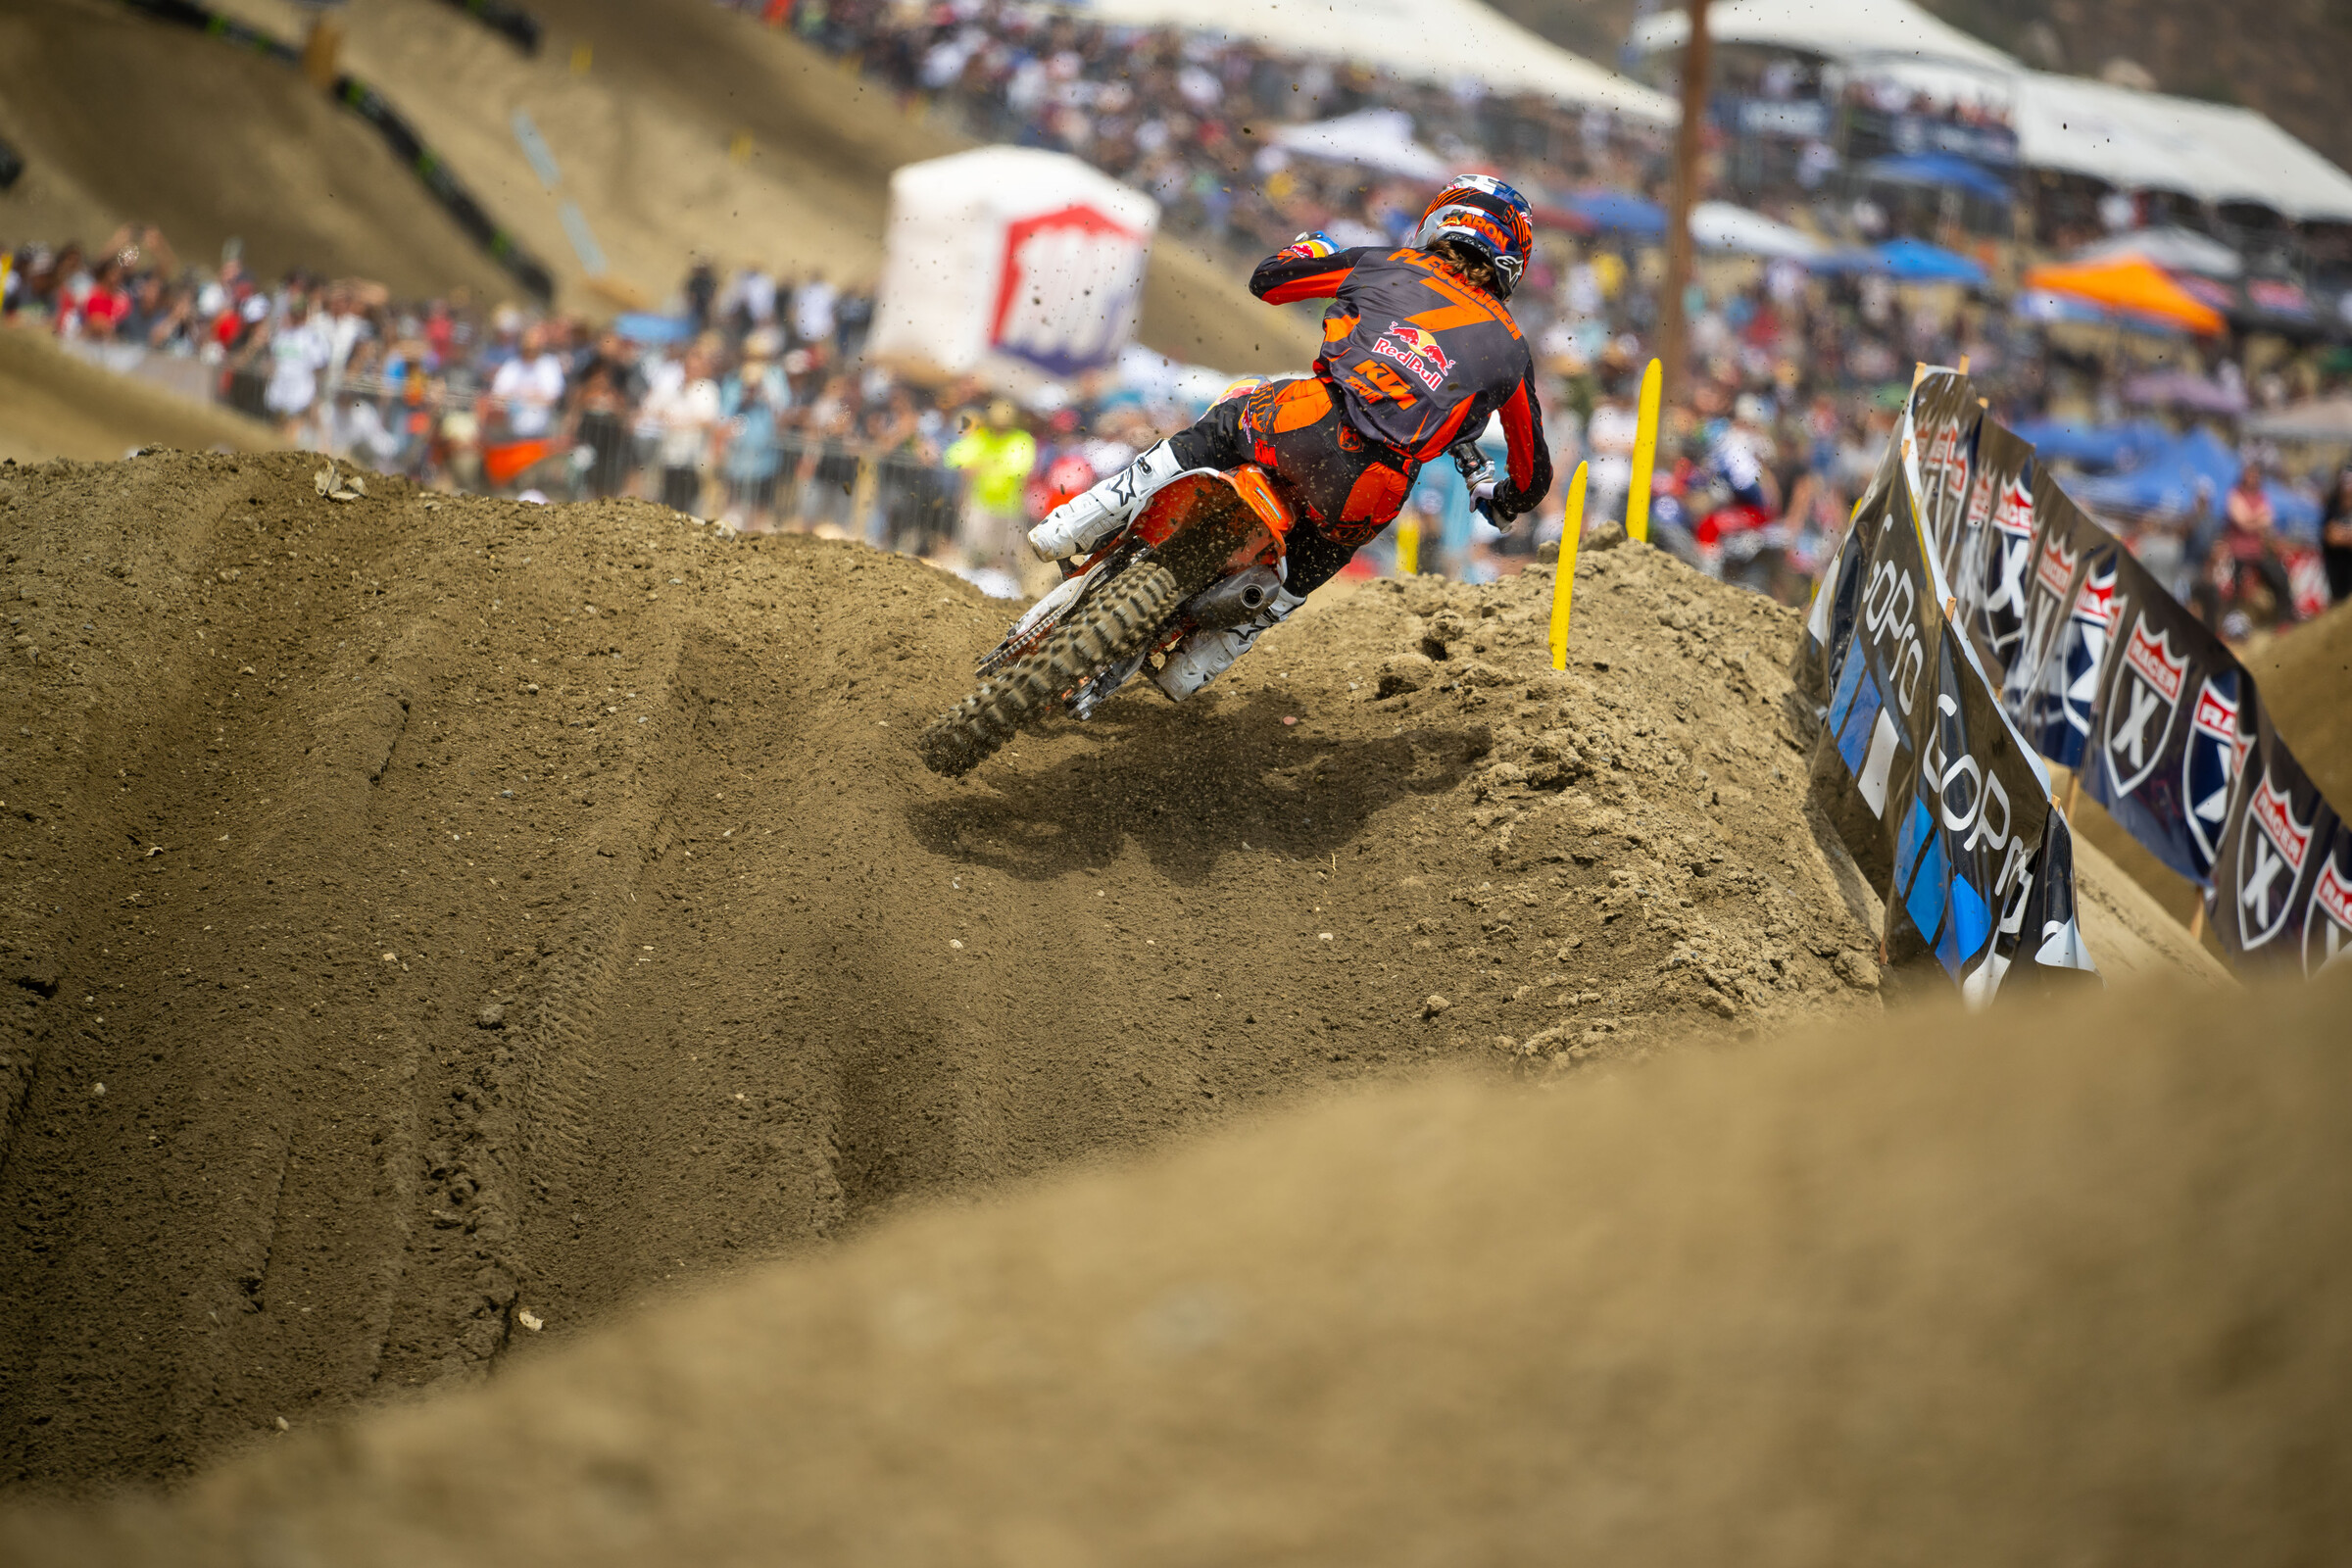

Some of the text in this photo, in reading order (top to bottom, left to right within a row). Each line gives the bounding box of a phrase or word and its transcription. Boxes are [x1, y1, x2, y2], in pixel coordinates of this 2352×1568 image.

[1441, 213, 1511, 254] AARON
[1403, 276, 1496, 333] 7
[1352, 359, 1418, 411] KTM
[1371, 336, 1444, 392] Red Bull
[2130, 640, 2180, 696] RACER
[2110, 675, 2160, 770] X
[2257, 790, 2304, 862] RACER
[2242, 833, 2283, 931] X
